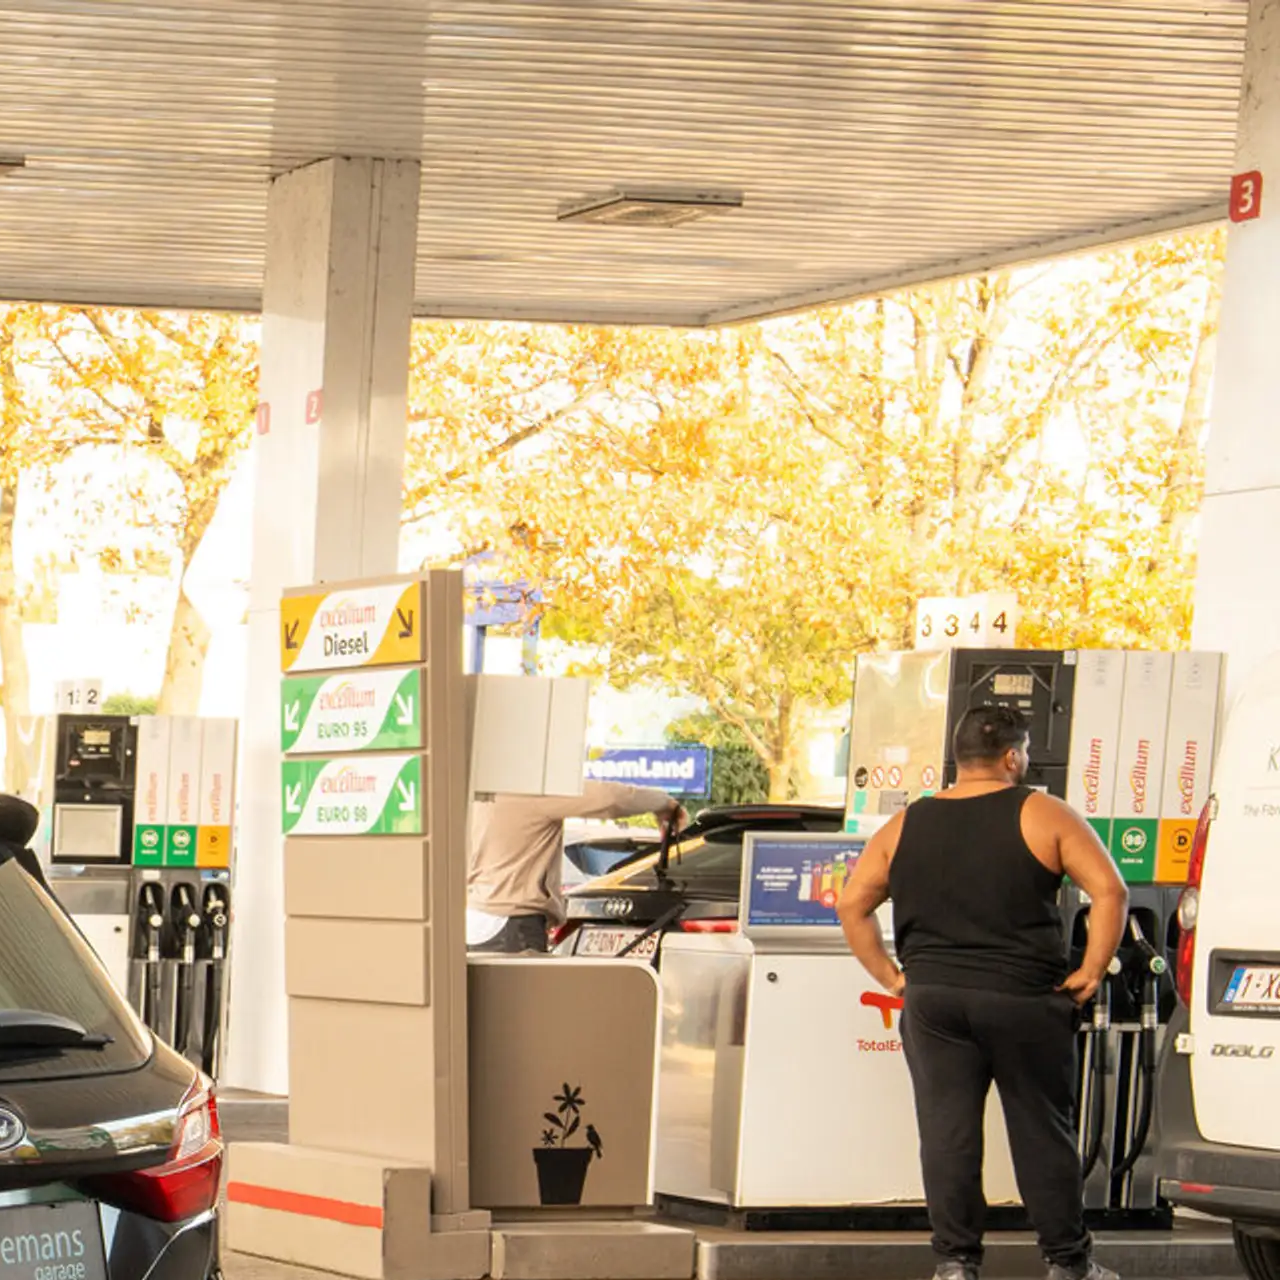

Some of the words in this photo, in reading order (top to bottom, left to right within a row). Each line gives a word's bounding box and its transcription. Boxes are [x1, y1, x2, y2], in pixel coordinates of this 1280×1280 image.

[1238, 179, 1254, 214] 3
[921, 613, 933, 637] 3
[944, 614, 959, 637] 3
[969, 611, 980, 633] 4
[992, 610, 1007, 634] 4
[324, 631, 369, 657] Diesel
[67, 690, 76, 705] 1
[87, 689, 98, 705] 2
[316, 722, 350, 739] EURO
[584, 757, 695, 779] reamLand
[1085, 738, 1103, 814] excellium
[1131, 739, 1150, 814] excellium
[1179, 740, 1198, 815] excellium
[316, 806, 350, 822] EURO
[1177, 835, 1187, 847] D
